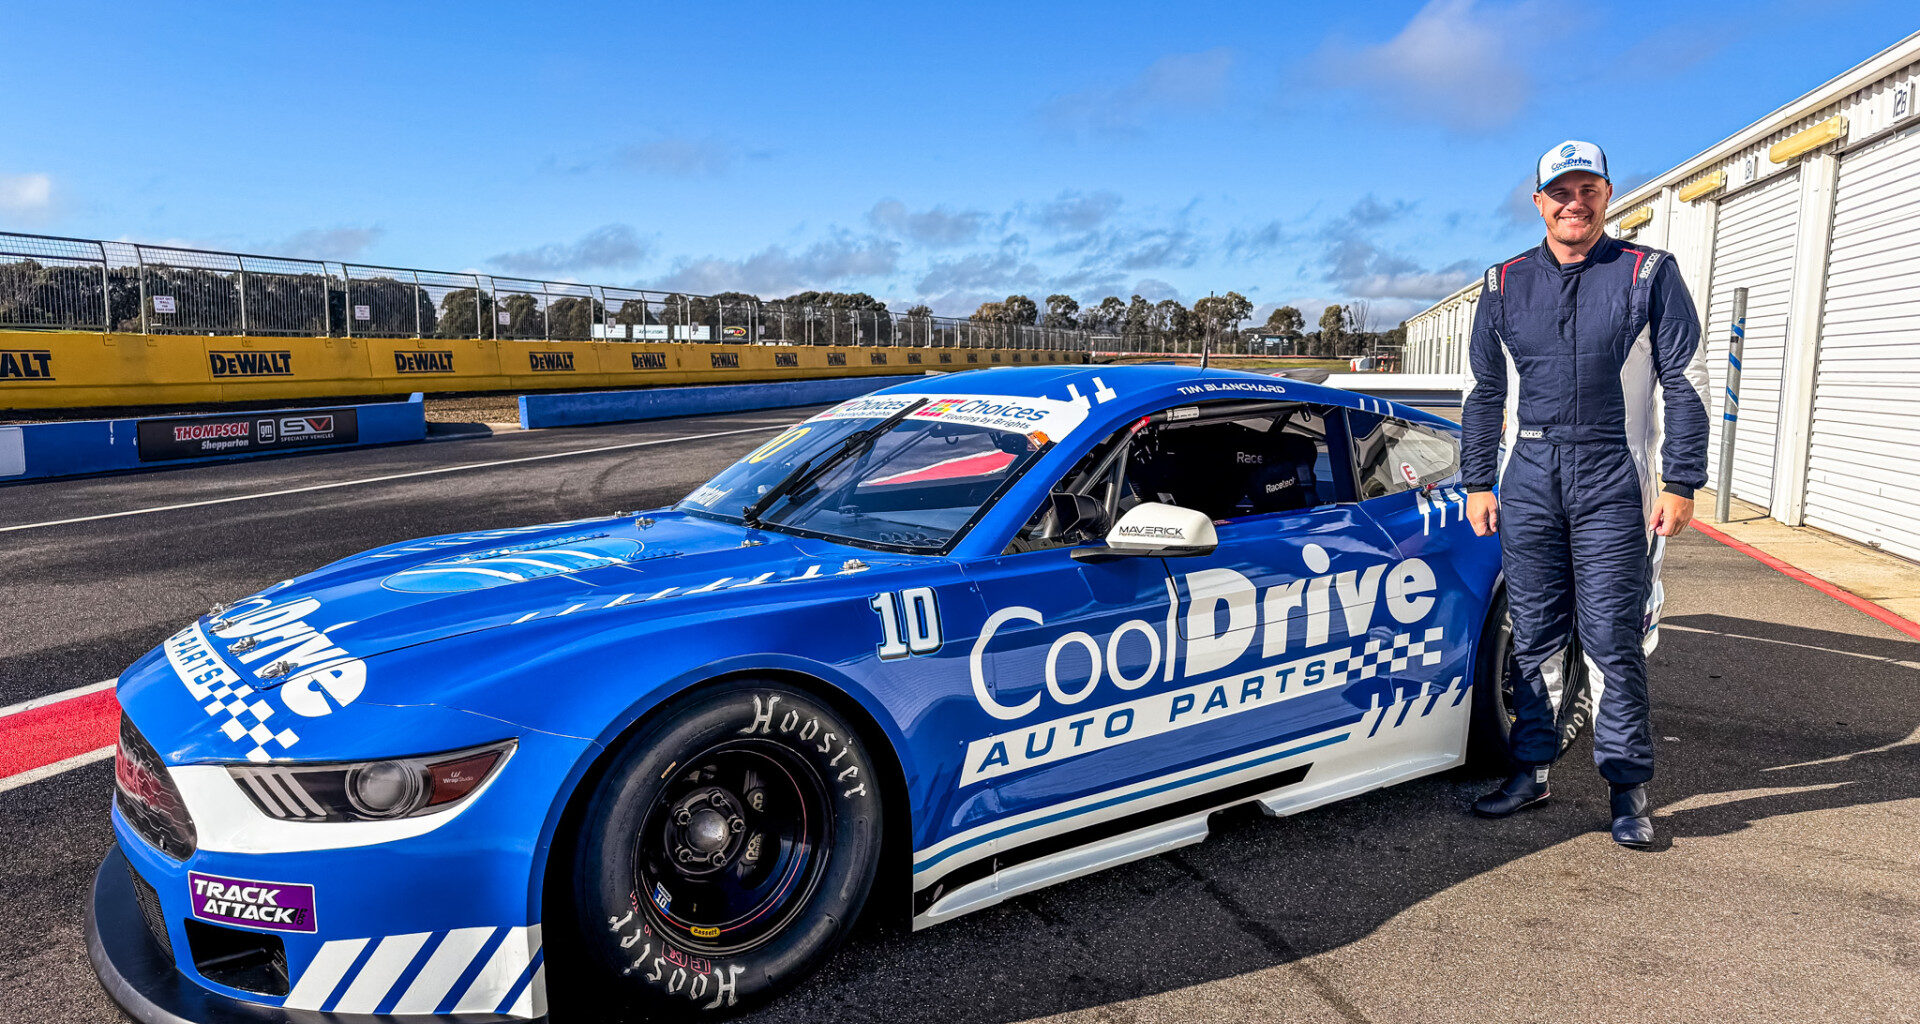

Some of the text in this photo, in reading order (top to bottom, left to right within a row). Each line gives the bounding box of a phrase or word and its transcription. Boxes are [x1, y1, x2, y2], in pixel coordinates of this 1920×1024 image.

[0, 353, 52, 377] ALT
[1177, 383, 1286, 395] TIM BLANCHARD
[956, 399, 1050, 421] Choices
[174, 421, 249, 441] THOMPSON
[942, 414, 1031, 430] Flooring by Brights
[201, 438, 249, 450] Shepparton
[281, 433, 334, 443] SPECIALTY VEHICLES
[1236, 452, 1263, 464] Race
[1119, 526, 1184, 536] MAVERICK
[868, 586, 944, 661] 10
[969, 543, 1438, 720] CoolDrive
[172, 636, 224, 685] PARTS
[976, 658, 1328, 774] AUTO PARTS
[738, 695, 866, 798] Hoosier
[194, 879, 281, 906] TRACK
[655, 893, 668, 909] 10
[203, 898, 296, 924] ATTACK
[608, 910, 746, 1010] Hoosier
